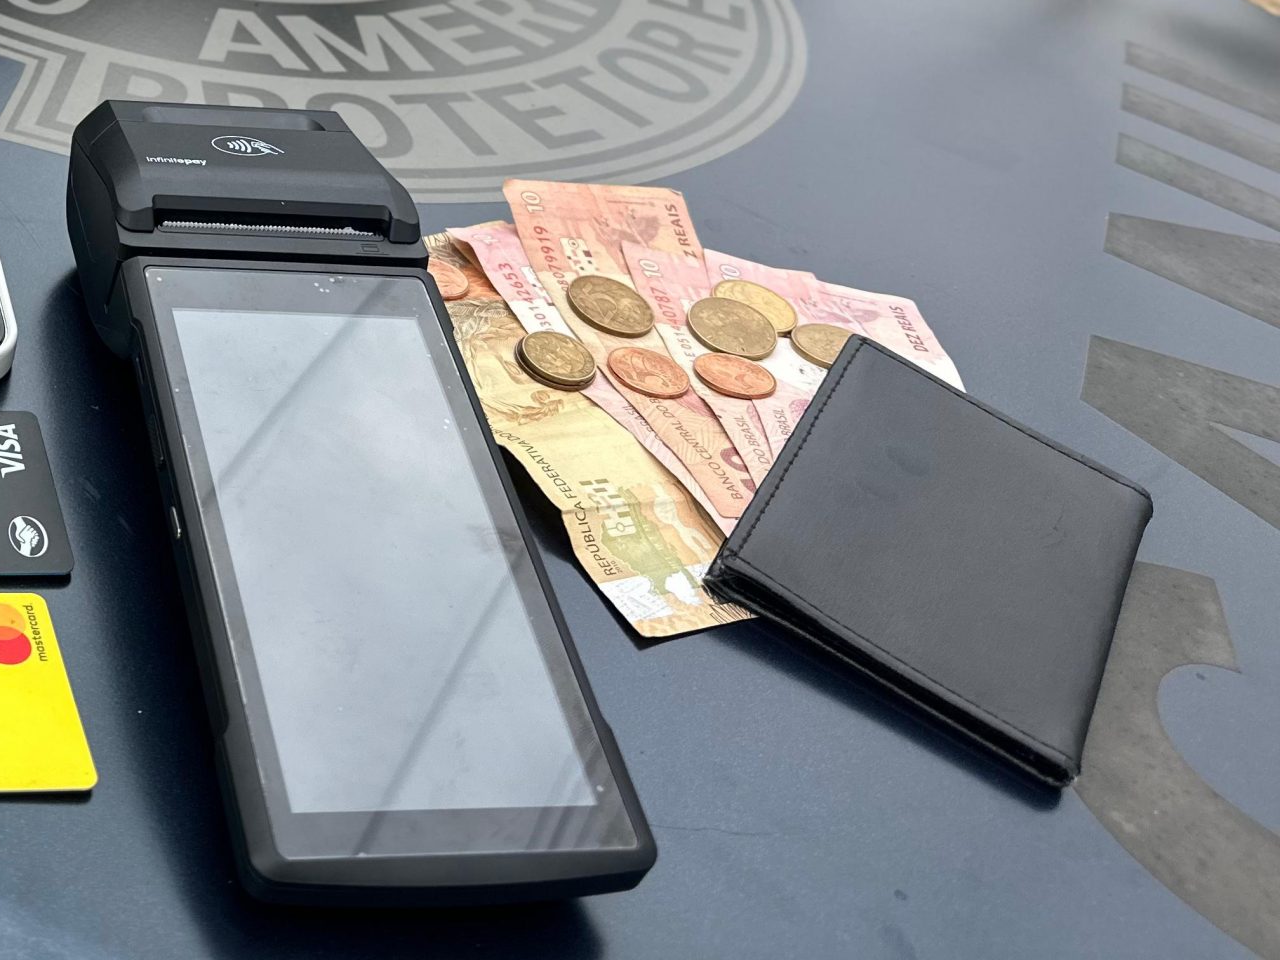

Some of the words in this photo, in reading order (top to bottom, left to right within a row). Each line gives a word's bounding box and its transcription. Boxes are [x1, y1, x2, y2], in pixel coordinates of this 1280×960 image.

[521, 191, 545, 214] 10
[665, 204, 689, 246] REAIS
[640, 259, 663, 278] 10
[889, 305, 916, 332] REAIS
[905, 333, 929, 352] DEZ
[656, 405, 676, 419] DO
[671, 421, 714, 460] CENTRAL
[733, 416, 761, 447] BRASIL
[518, 440, 577, 500] FEDERATIVA
[753, 448, 771, 465] DO
[708, 461, 744, 500] BANCO
[574, 501, 617, 576] REPÚBLICA
[23, 604, 48, 662] mastercard
